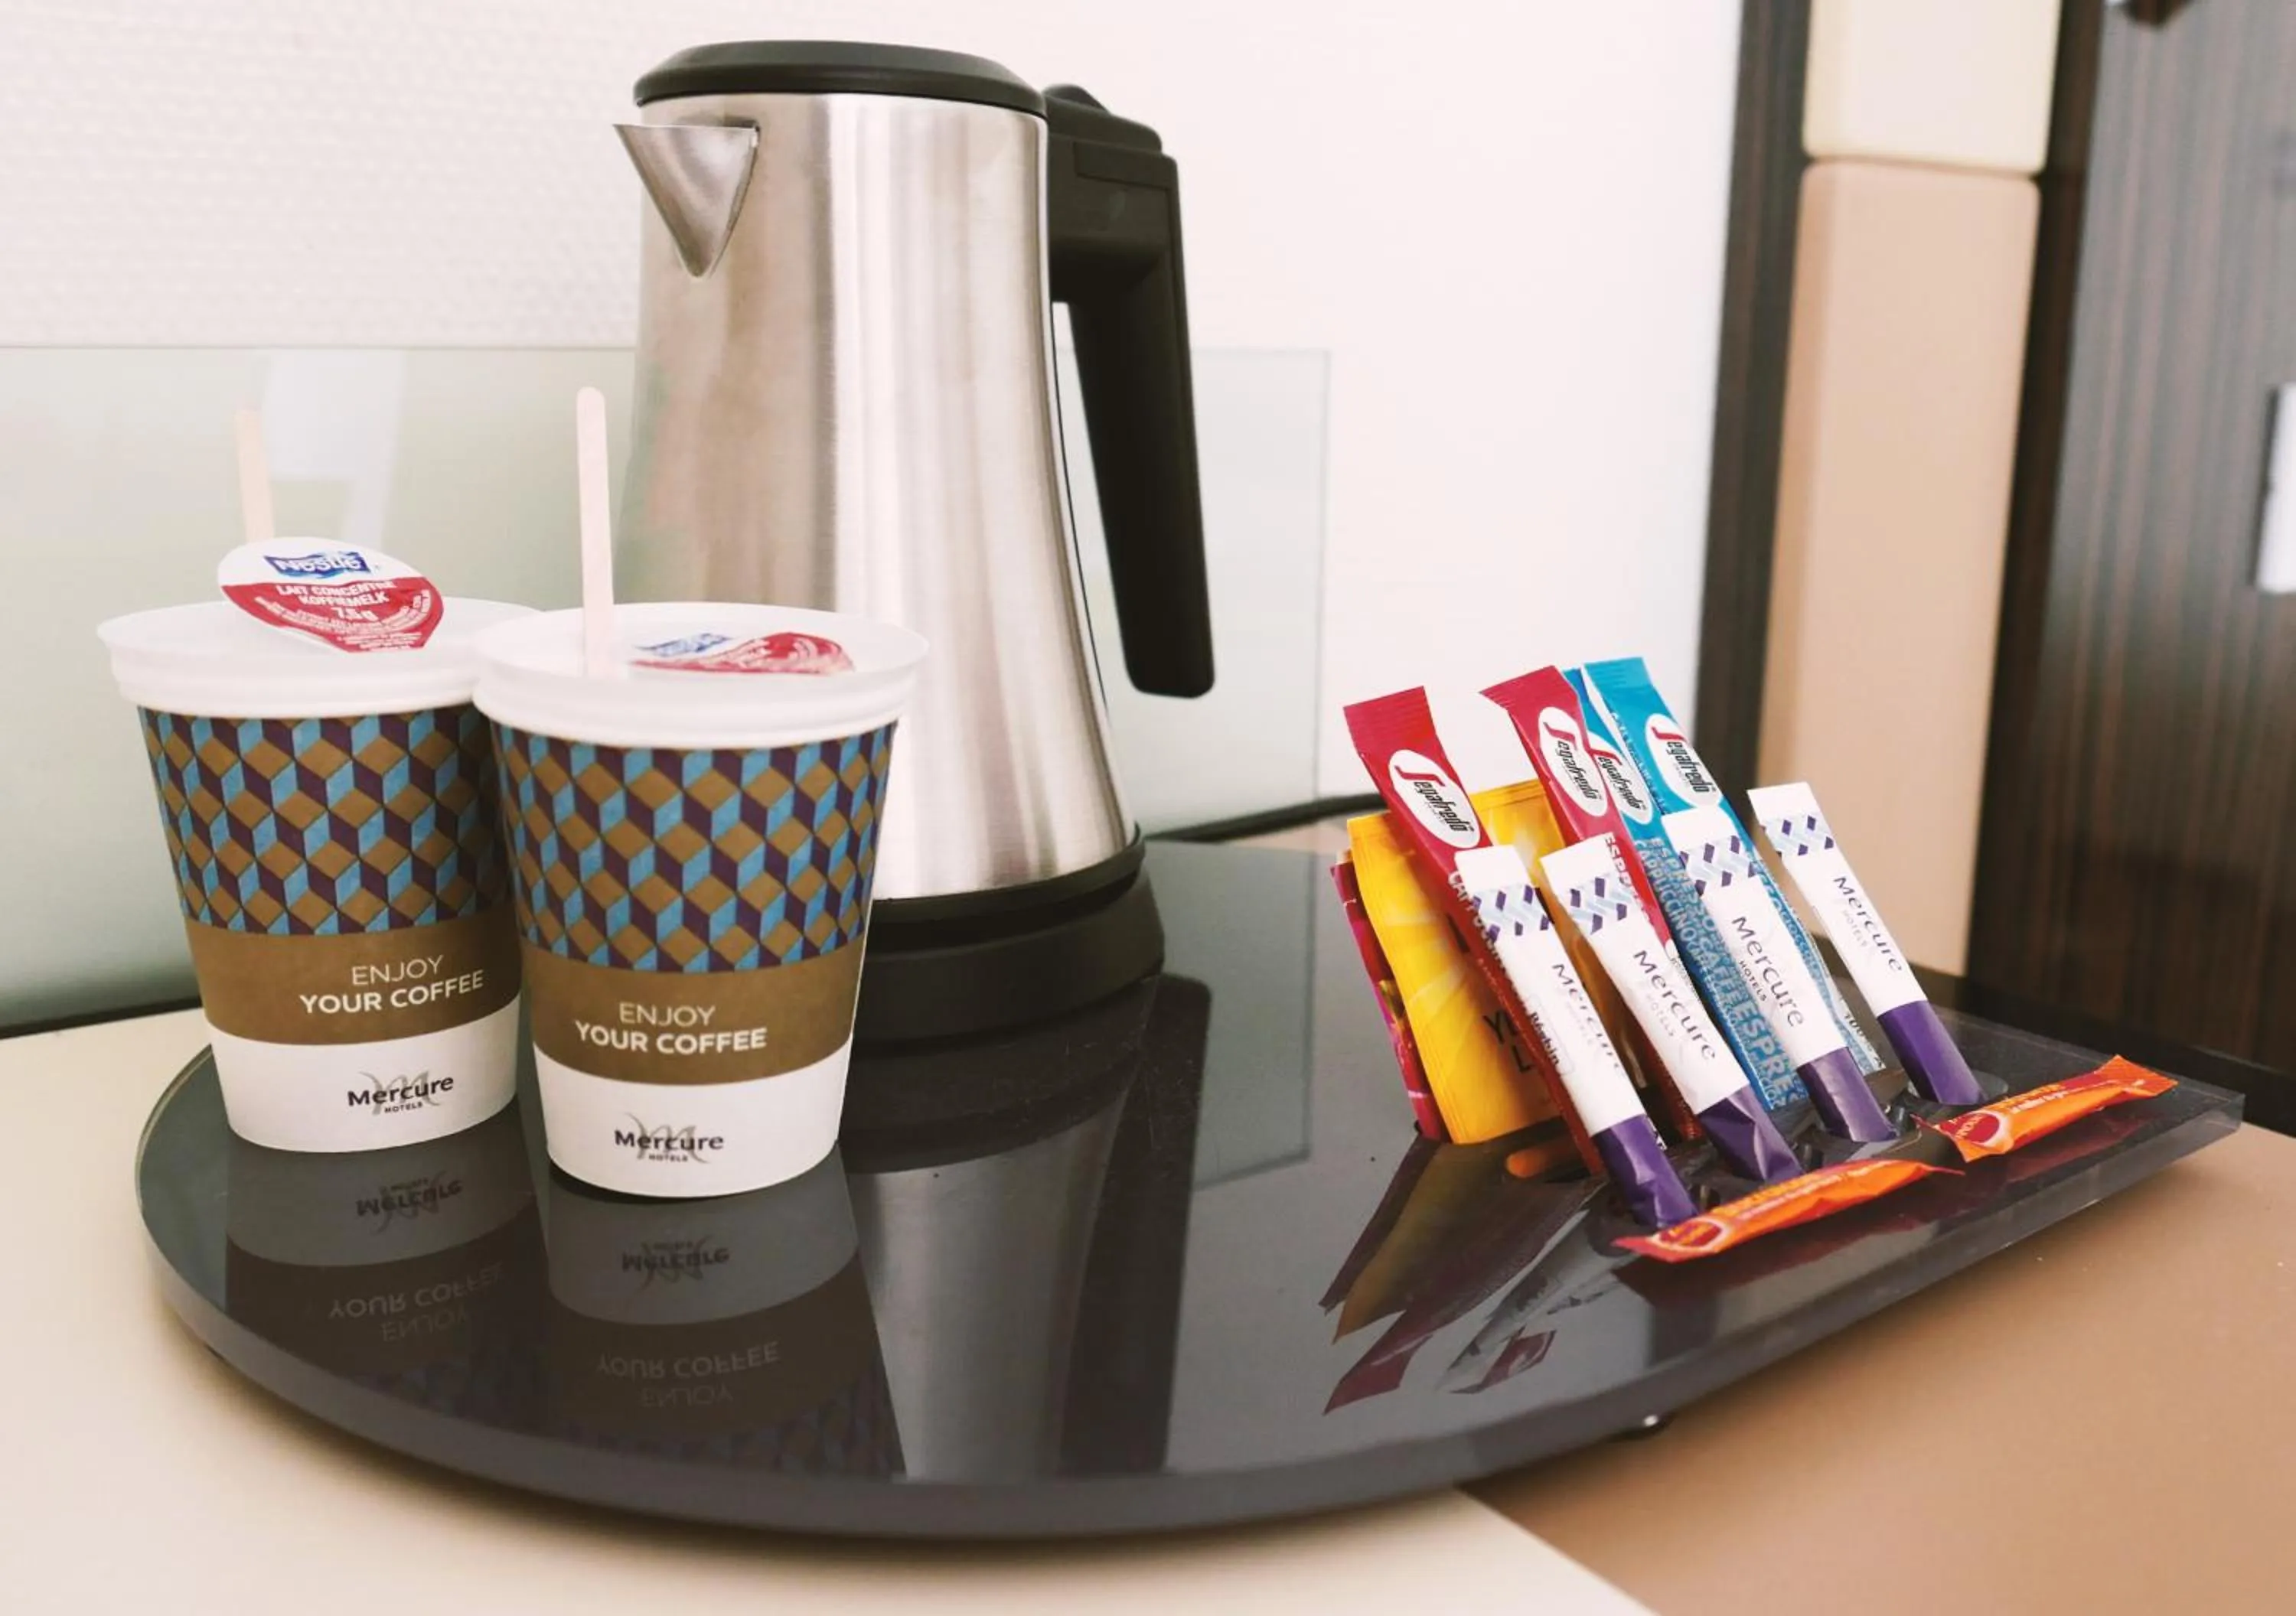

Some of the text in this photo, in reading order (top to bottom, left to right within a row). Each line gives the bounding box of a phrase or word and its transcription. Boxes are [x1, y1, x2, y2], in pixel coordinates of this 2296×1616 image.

[276, 585, 308, 595] LAIT
[1833, 876, 1905, 973] Mercure
[351, 955, 444, 986] ENJOY
[1731, 916, 1805, 1028] Mercure
[1738, 960, 1768, 1002] HOTELS
[299, 969, 484, 1014] YOUR COFFEE
[1633, 950, 1716, 1060] Mercure
[619, 1002, 716, 1028] ENJOY
[576, 1020, 768, 1055] YOUR COFFEE
[348, 1077, 455, 1106] Mercure
[384, 1103, 423, 1114] HOTELS
[615, 1129, 724, 1151] Mercure
[649, 1153, 688, 1162] HOTELS
